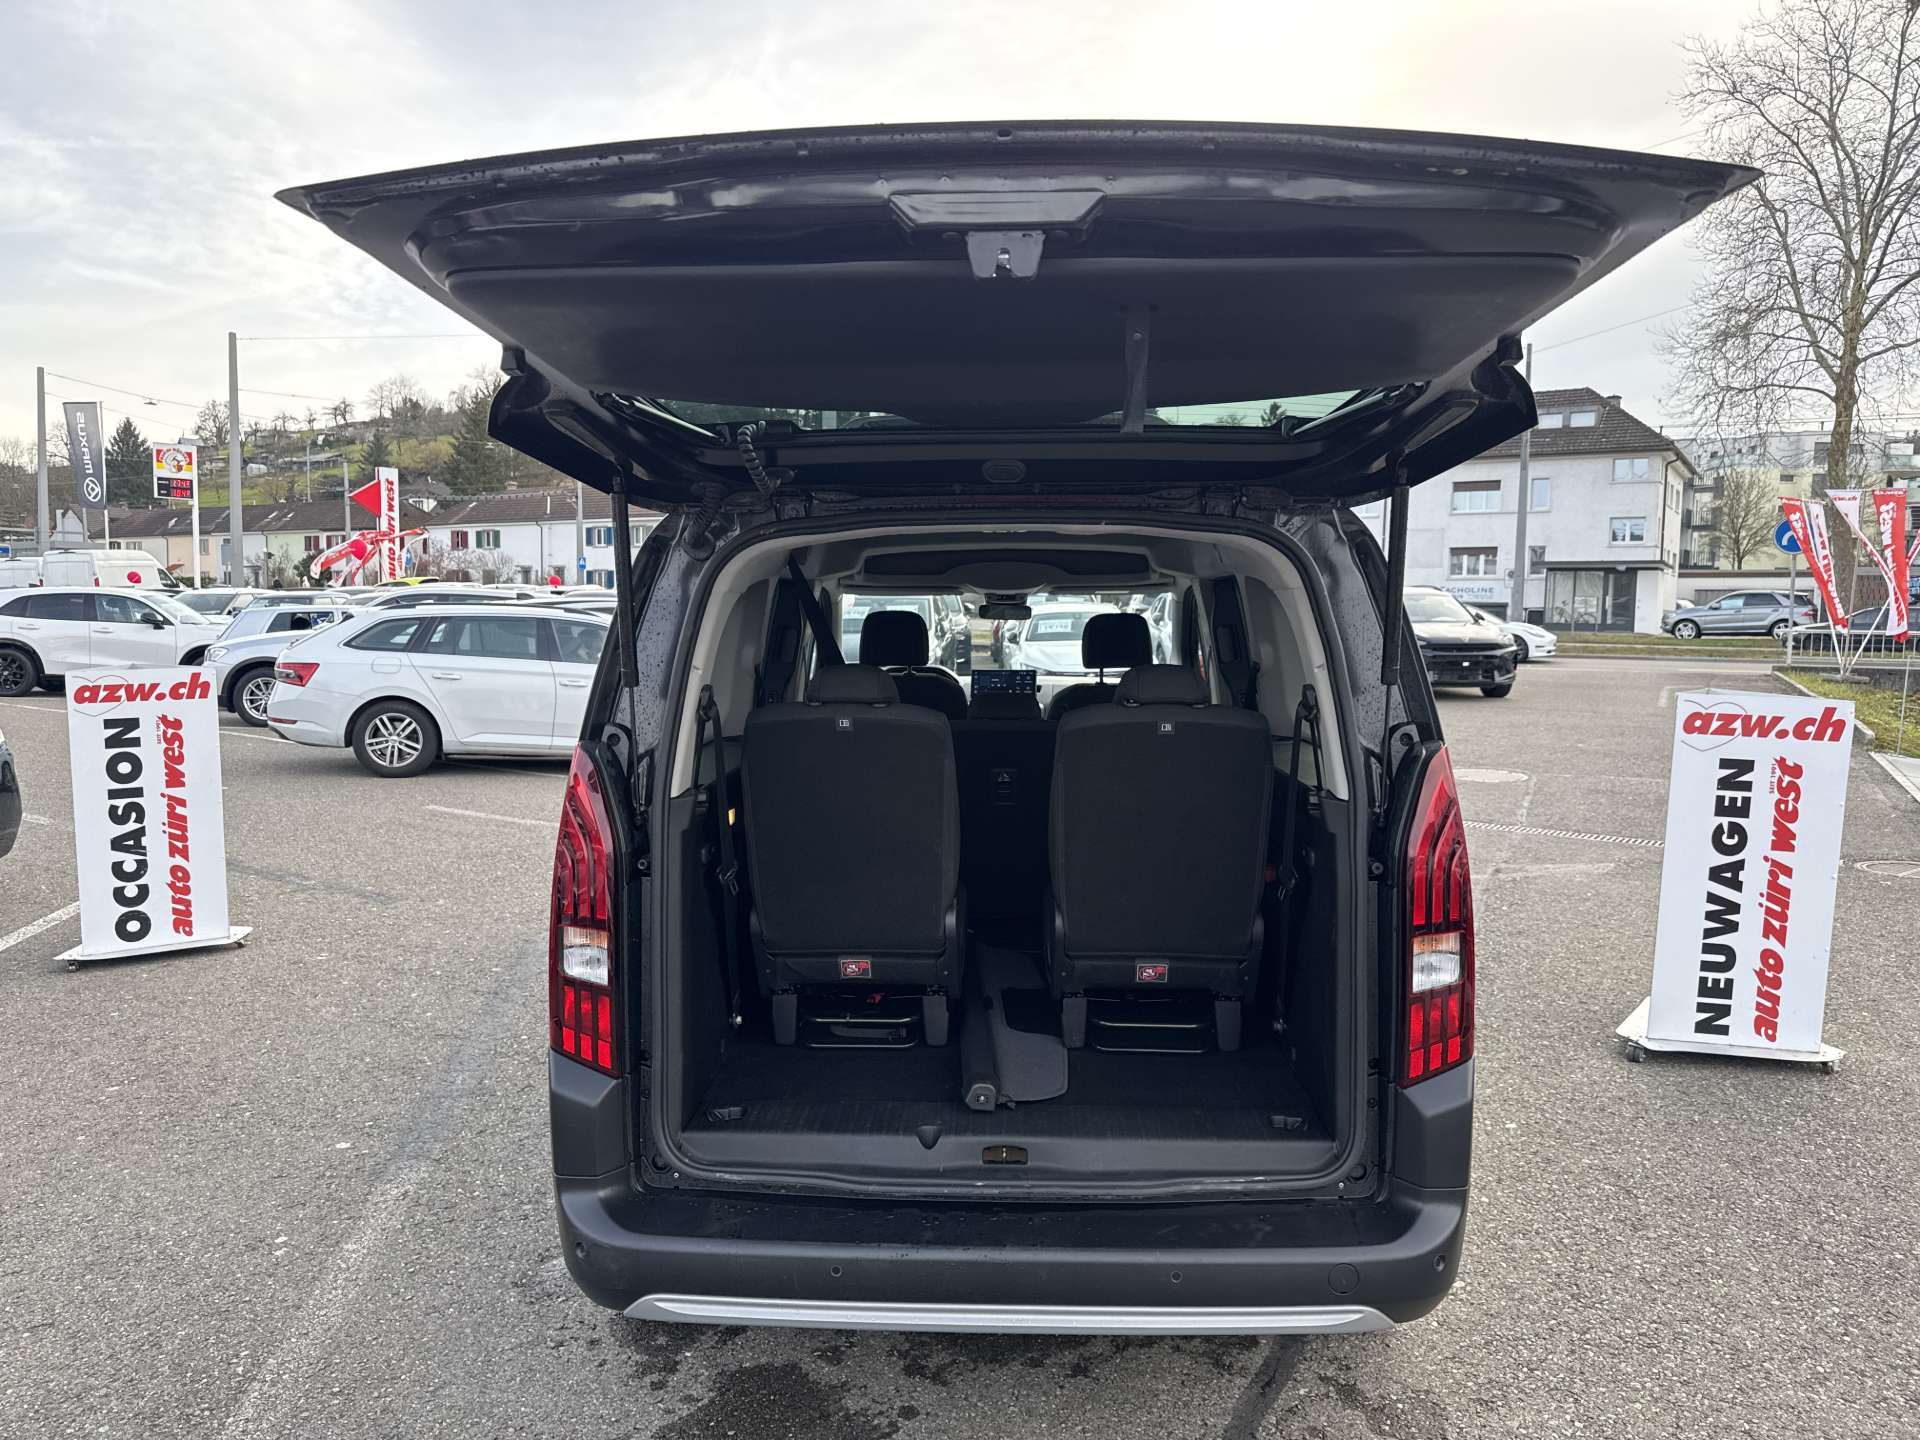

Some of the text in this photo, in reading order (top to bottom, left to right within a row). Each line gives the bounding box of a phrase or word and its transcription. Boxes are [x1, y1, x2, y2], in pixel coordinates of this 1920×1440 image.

[386, 478, 395, 513] west
[388, 546, 397, 580] auto
[73, 672, 211, 704] azw.ch
[1682, 706, 1847, 743] azw.ch
[103, 717, 152, 943] OCCASION
[156, 713, 194, 937] auto züri west
[1694, 757, 1756, 1037] NEUWAGEN
[1753, 755, 1804, 1043] auto züri west
